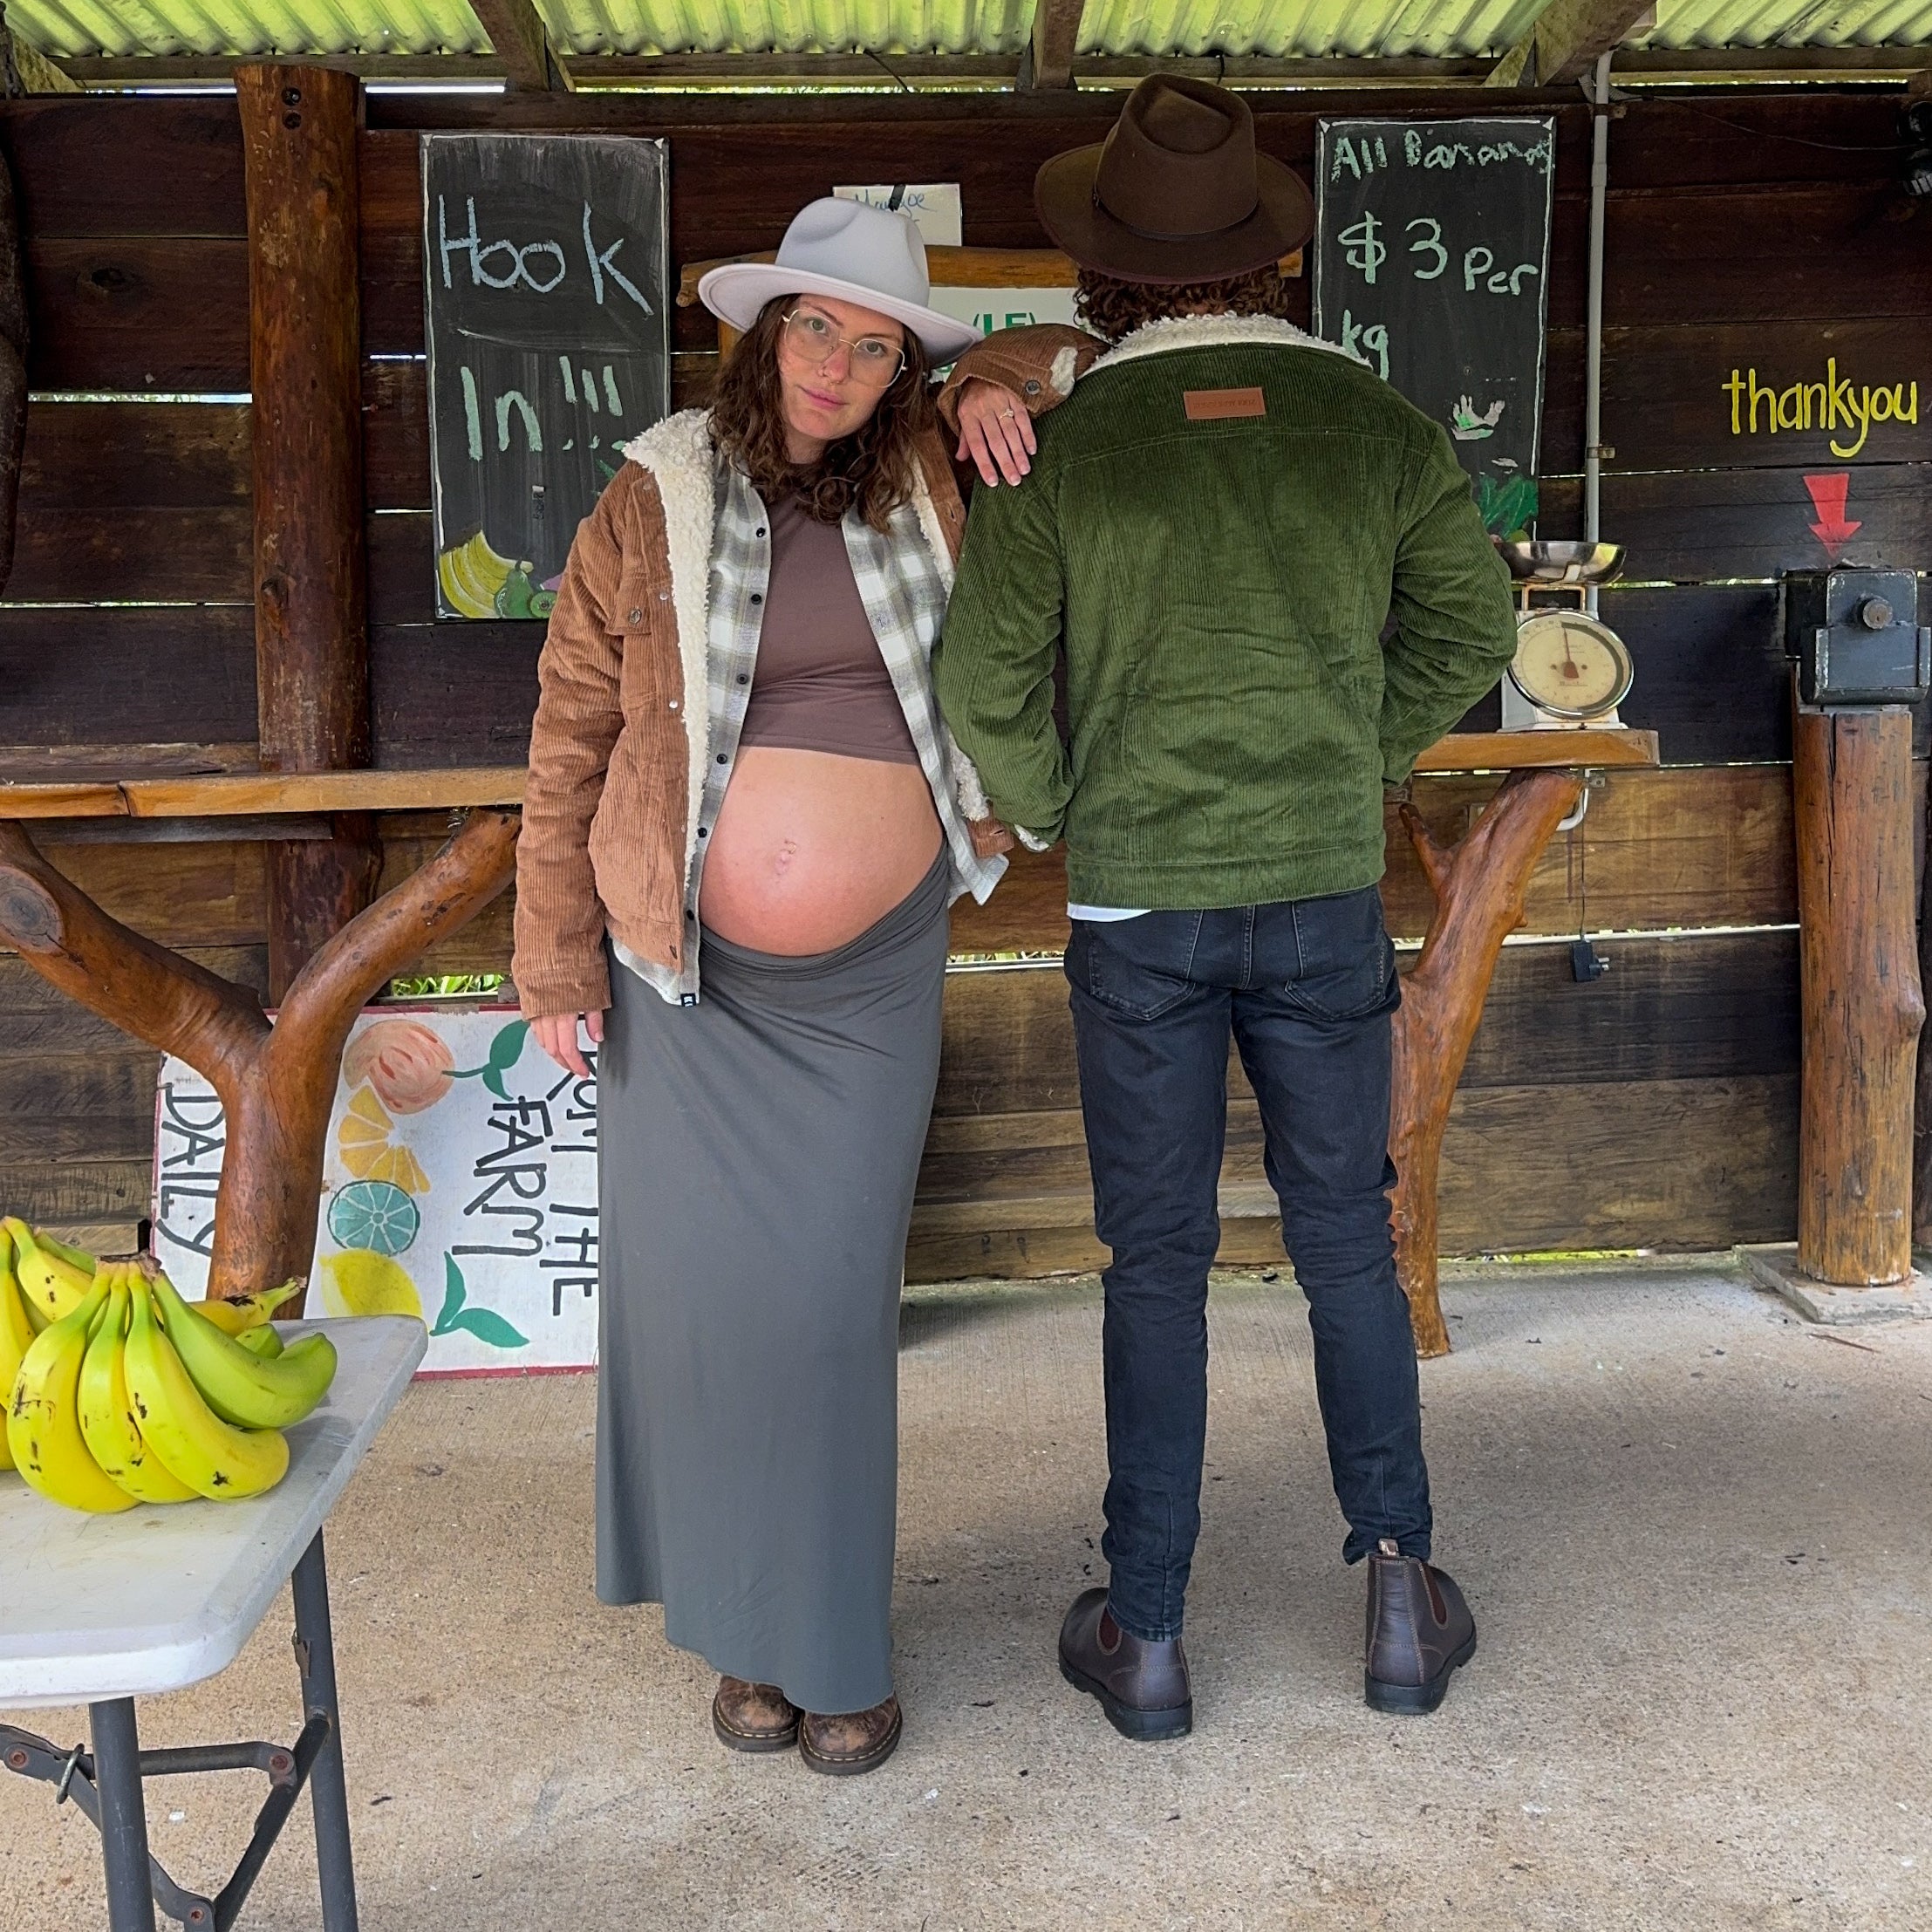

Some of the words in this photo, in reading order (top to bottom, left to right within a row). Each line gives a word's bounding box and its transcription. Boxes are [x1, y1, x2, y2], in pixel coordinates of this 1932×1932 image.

[1331, 136, 1388, 183] All
[439, 194, 653, 315] Hook
[1341, 309, 1389, 380] kg
[1722, 357, 1917, 458] thankyou
[157, 1082, 225, 1257] DAILY
[452, 1096, 553, 1256] FARM
